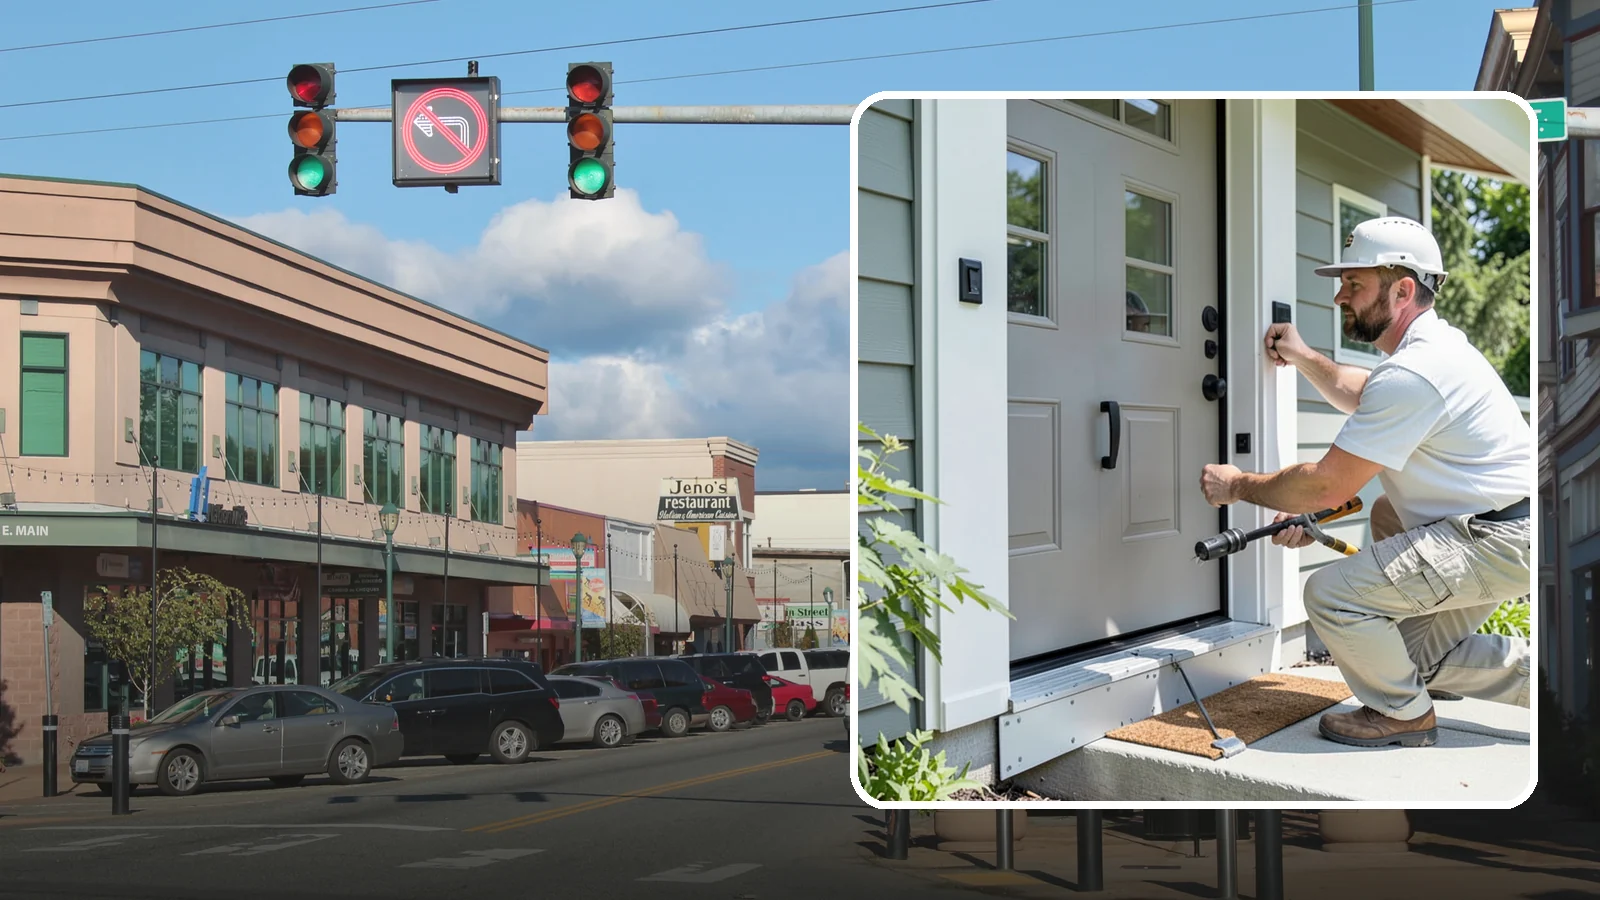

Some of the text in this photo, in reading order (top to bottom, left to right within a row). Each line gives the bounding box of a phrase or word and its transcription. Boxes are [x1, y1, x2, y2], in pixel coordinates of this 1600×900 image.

[670, 480, 727, 494] Jeno's
[665, 496, 731, 509] restaurant
[658, 510, 681, 519] Italian
[686, 509, 714, 519] American
[715, 509, 737, 519] Cuisine
[2, 525, 49, 536] E. MAIN
[786, 607, 795, 616] in
[797, 607, 828, 616] Street
